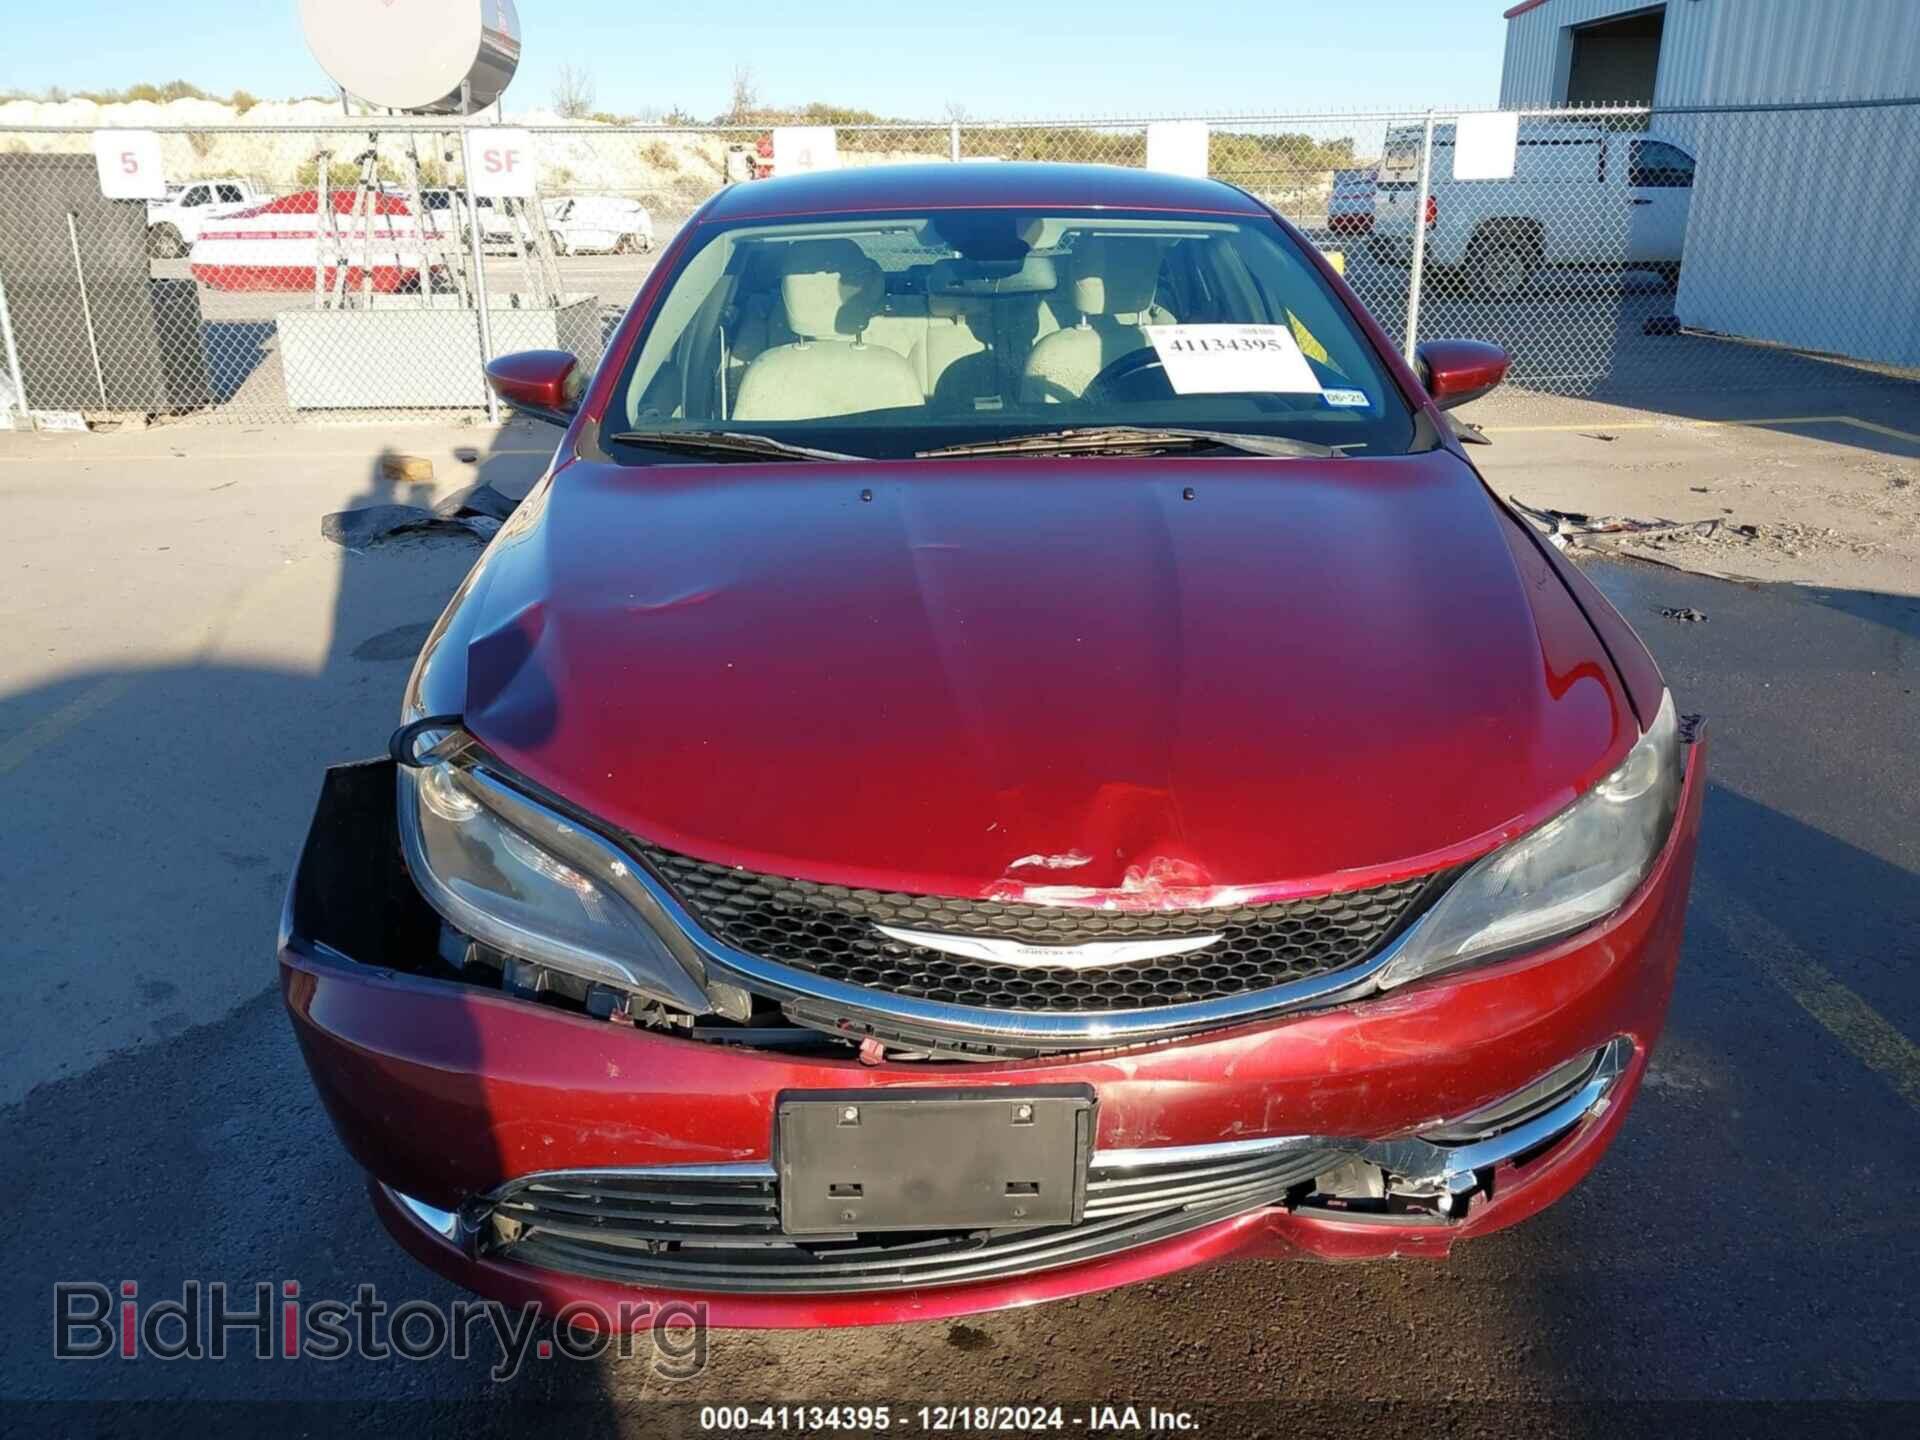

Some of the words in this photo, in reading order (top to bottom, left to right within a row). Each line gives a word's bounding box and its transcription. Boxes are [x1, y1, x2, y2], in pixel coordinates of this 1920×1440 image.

[120, 151, 139, 175] 5
[483, 149, 521, 174] SF
[1169, 338, 1282, 353] 41134395
